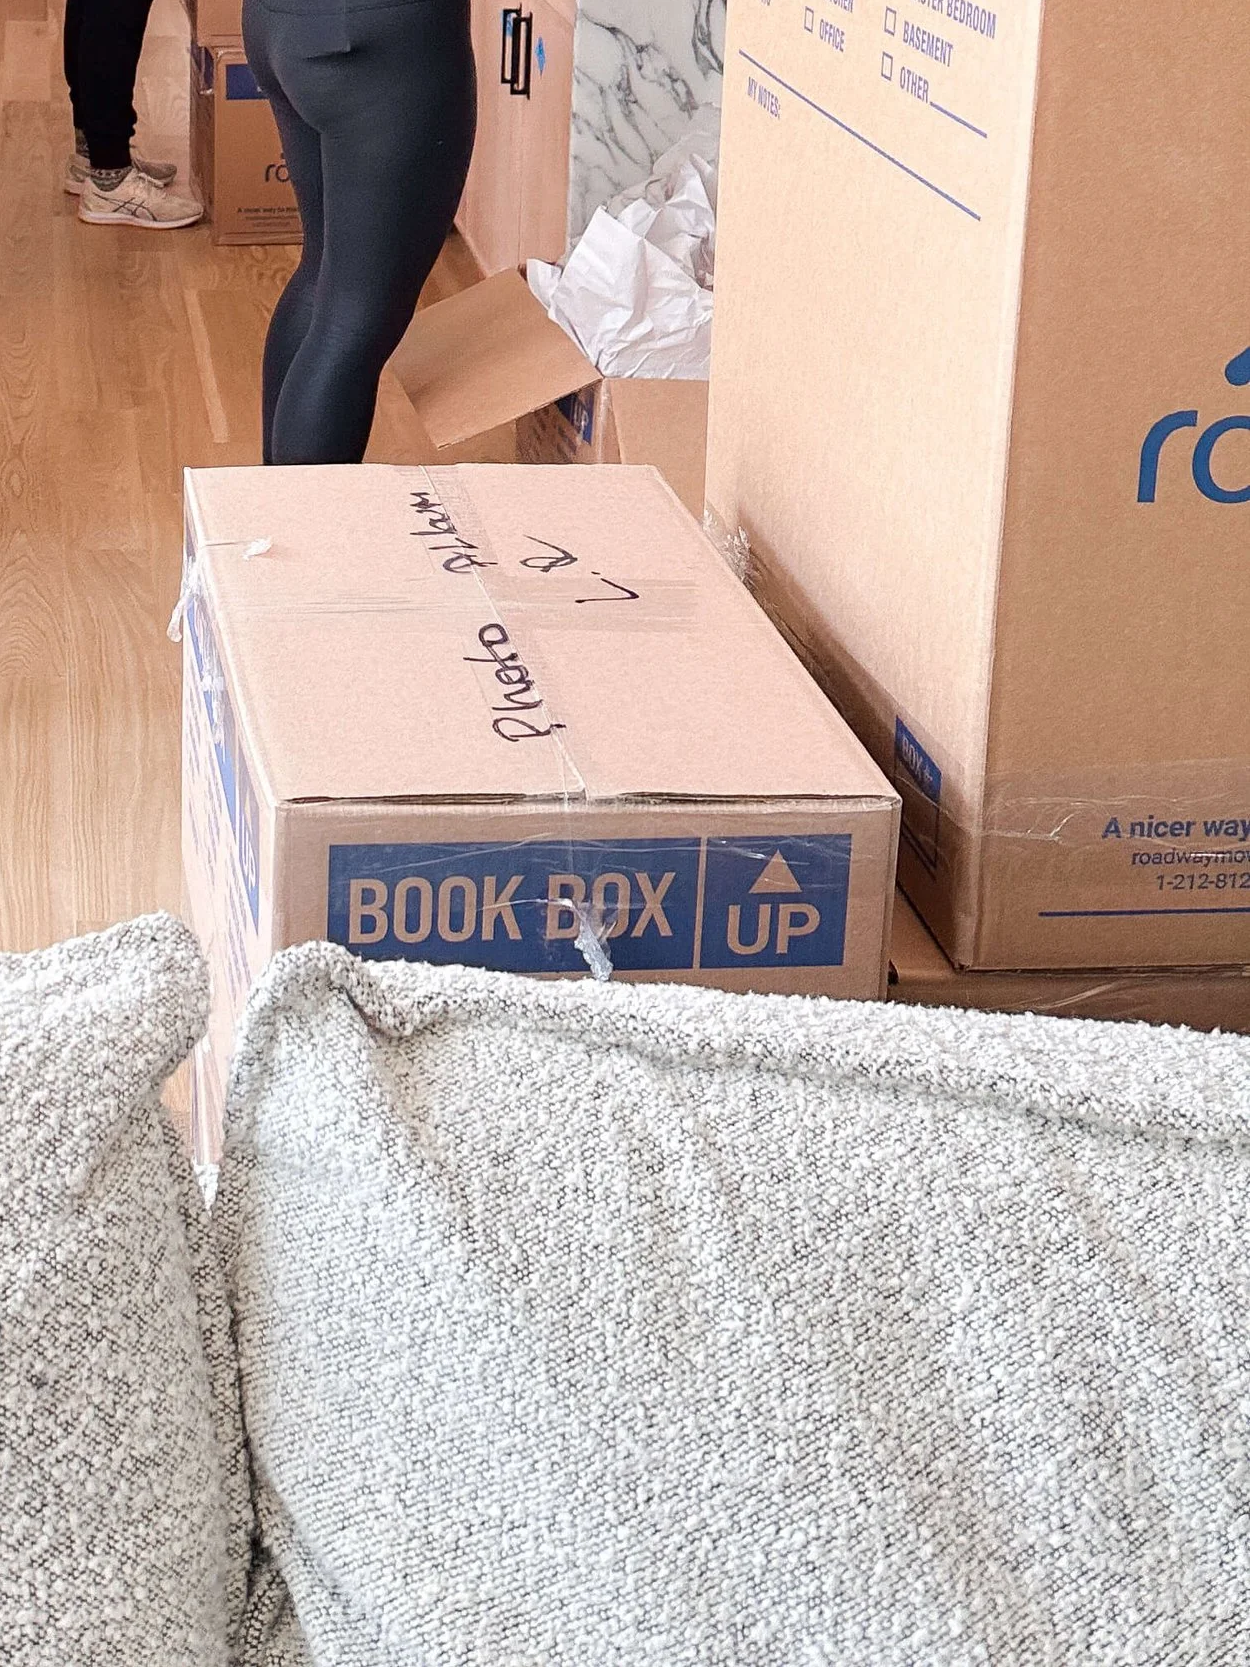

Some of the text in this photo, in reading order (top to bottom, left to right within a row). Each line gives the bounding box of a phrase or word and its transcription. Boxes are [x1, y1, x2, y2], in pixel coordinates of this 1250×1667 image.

[819, 18, 845, 53] OFFICE
[903, 20, 953, 67] BASEMENT
[747, 76, 759, 98] MY
[900, 66, 929, 104] OTHER
[463, 623, 567, 742] Photo
[1101, 814, 1250, 842] A nicer way
[349, 871, 676, 945] BOOK BOX
[726, 902, 821, 955] UP
